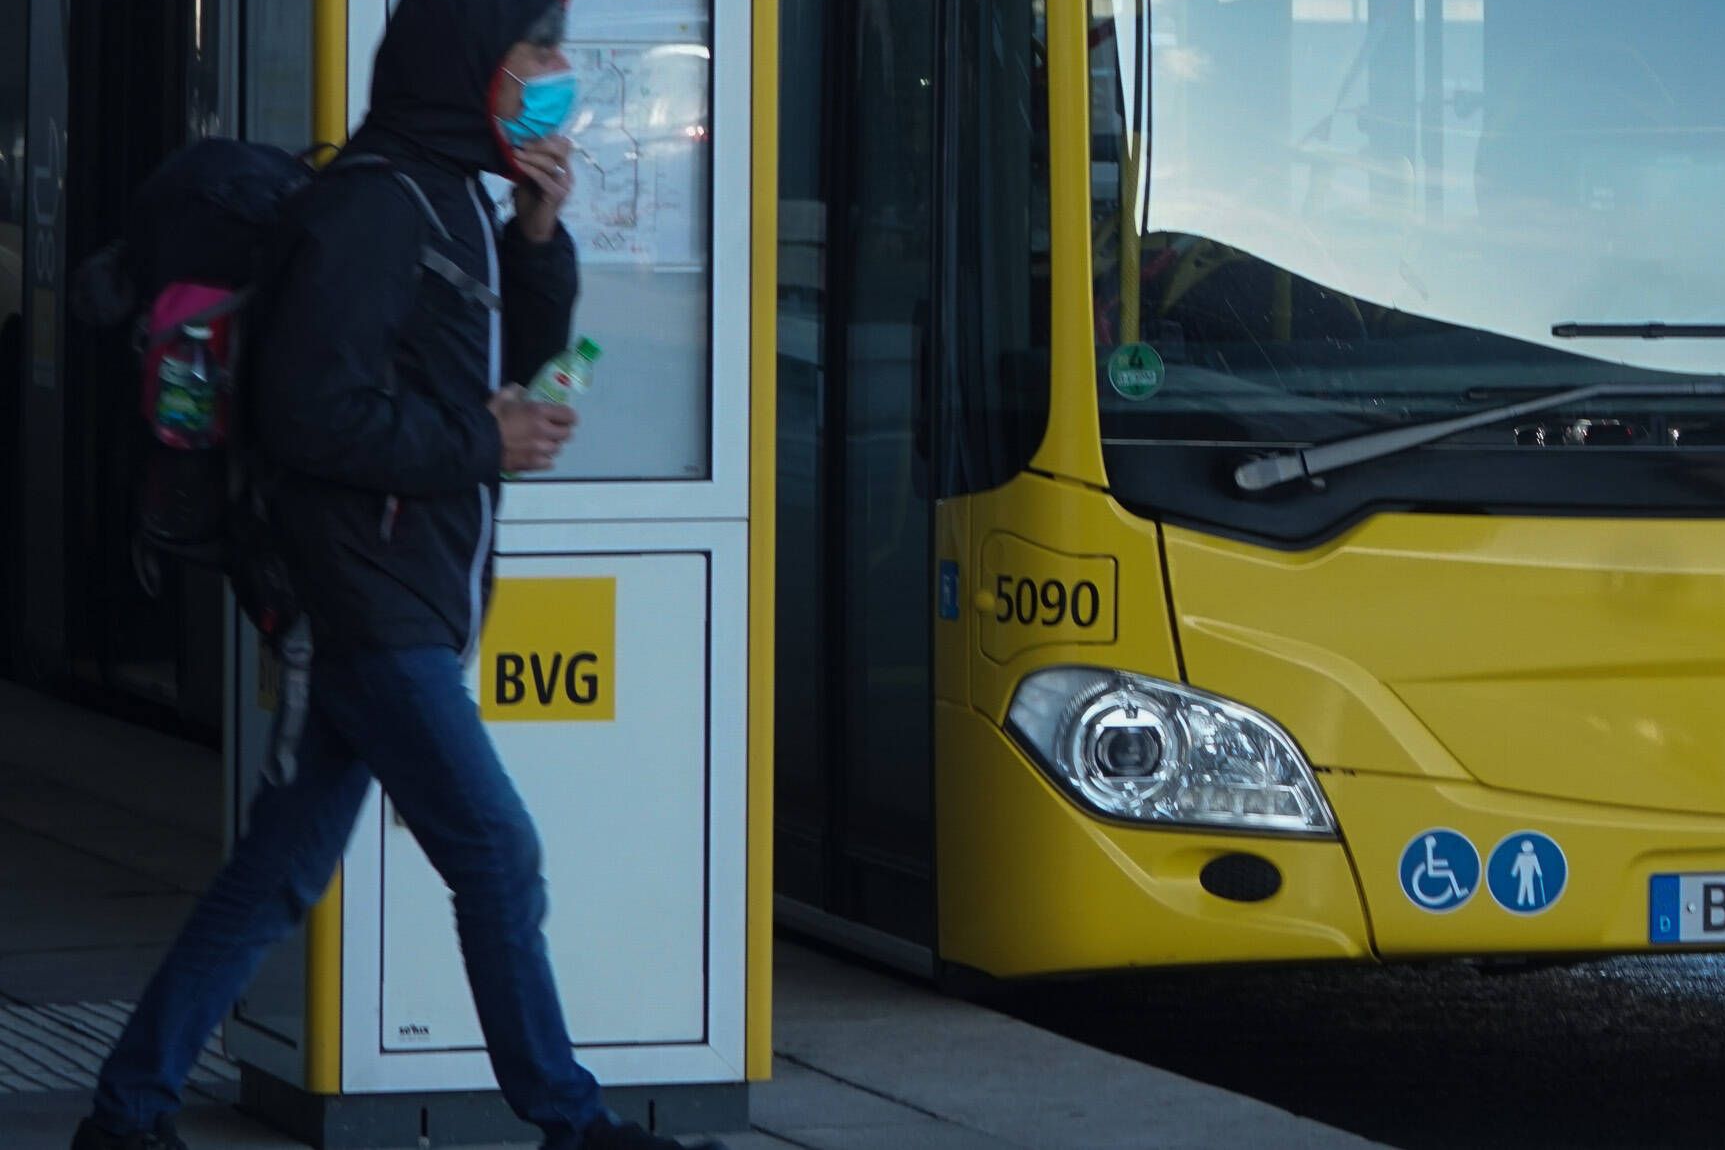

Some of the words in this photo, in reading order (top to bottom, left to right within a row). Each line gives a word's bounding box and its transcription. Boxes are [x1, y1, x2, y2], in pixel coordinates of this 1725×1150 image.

[996, 576, 1099, 627] 5090
[495, 652, 599, 706] BVG
[1660, 915, 1671, 933] D
